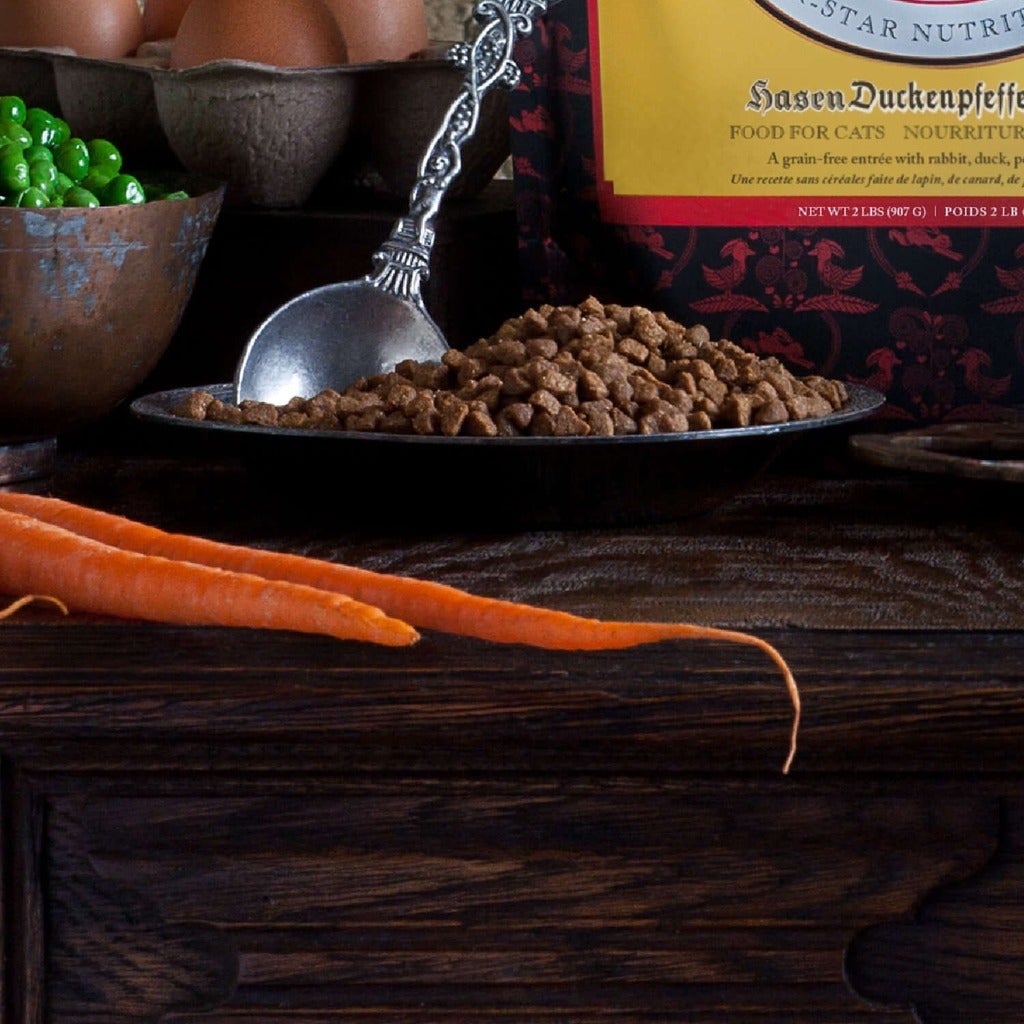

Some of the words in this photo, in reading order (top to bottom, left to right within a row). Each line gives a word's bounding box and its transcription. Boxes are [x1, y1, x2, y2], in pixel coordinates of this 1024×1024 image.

[729, 124, 784, 140] FOOD
[789, 124, 830, 140] FOR
[834, 124, 885, 140] CATS
[766, 151, 779, 165] A
[782, 151, 848, 169] grain-free
[850, 152, 893, 165] entrée
[895, 151, 925, 165] with
[928, 151, 972, 167] rabbit,
[974, 151, 1012, 167] duck,
[731, 174, 755, 185] Une
[756, 174, 794, 185] recette
[795, 176, 820, 185] sans
[866, 174, 895, 188] faite
[895, 173, 909, 185] de
[911, 173, 945, 188] lapin,
[947, 173, 961, 185] de
[962, 173, 1005, 187] canard,
[1007, 173, 1021, 185] de
[798, 206, 825, 217] NET
[827, 206, 850, 217] WT
[852, 206, 859, 217] 2
[861, 206, 885, 217] LBS
[886, 206, 910, 219] (907
[912, 206, 927, 219] G)
[945, 206, 987, 217] POIDS
[990, 206, 997, 217] 2
[1001, 206, 1018, 217] LB
